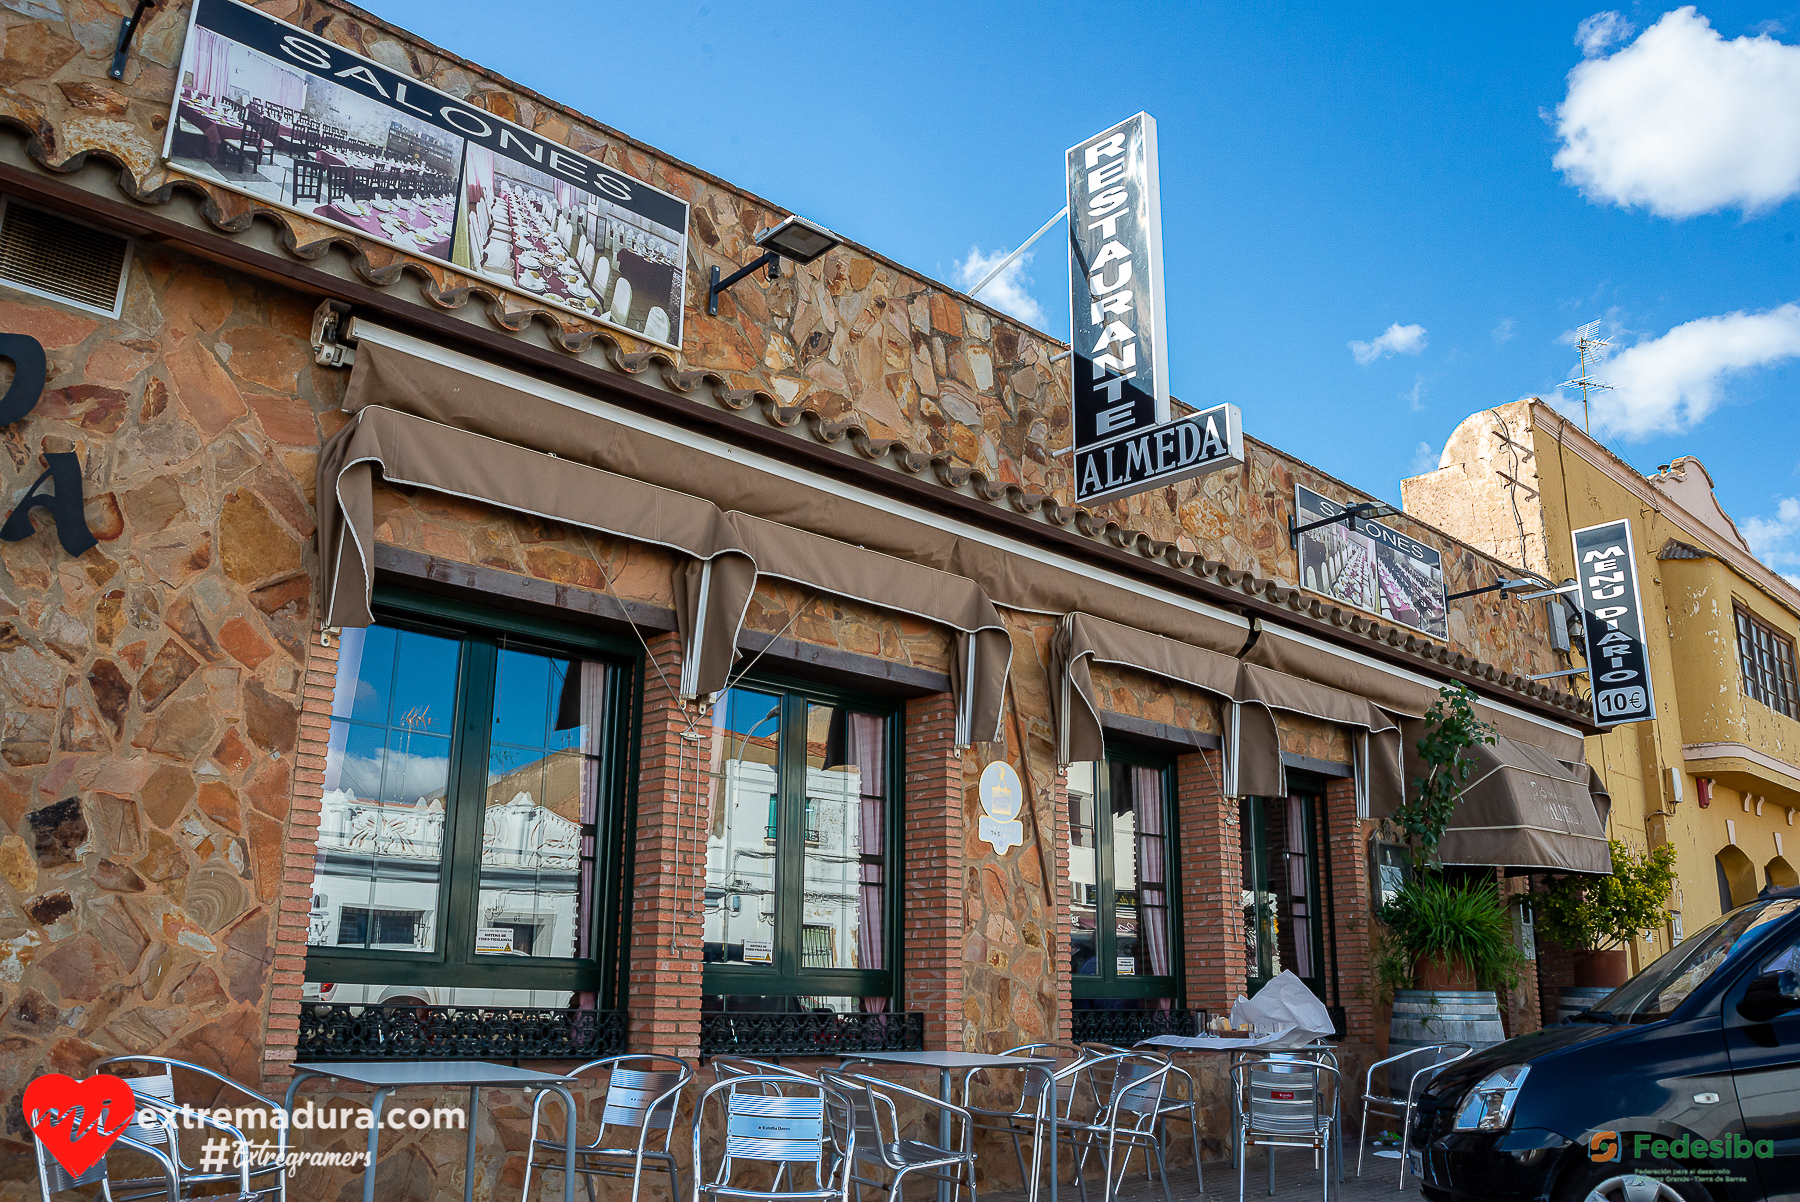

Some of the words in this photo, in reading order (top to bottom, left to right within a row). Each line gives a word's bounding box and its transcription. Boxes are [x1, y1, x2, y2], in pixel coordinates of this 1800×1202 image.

[280, 35, 632, 201] SALONES
[1084, 132, 1137, 436] RESTAURANTE
[1079, 415, 1227, 496] ALMEDA
[1320, 501, 1424, 559] SONES
[1594, 606, 1639, 682] DIARIO
